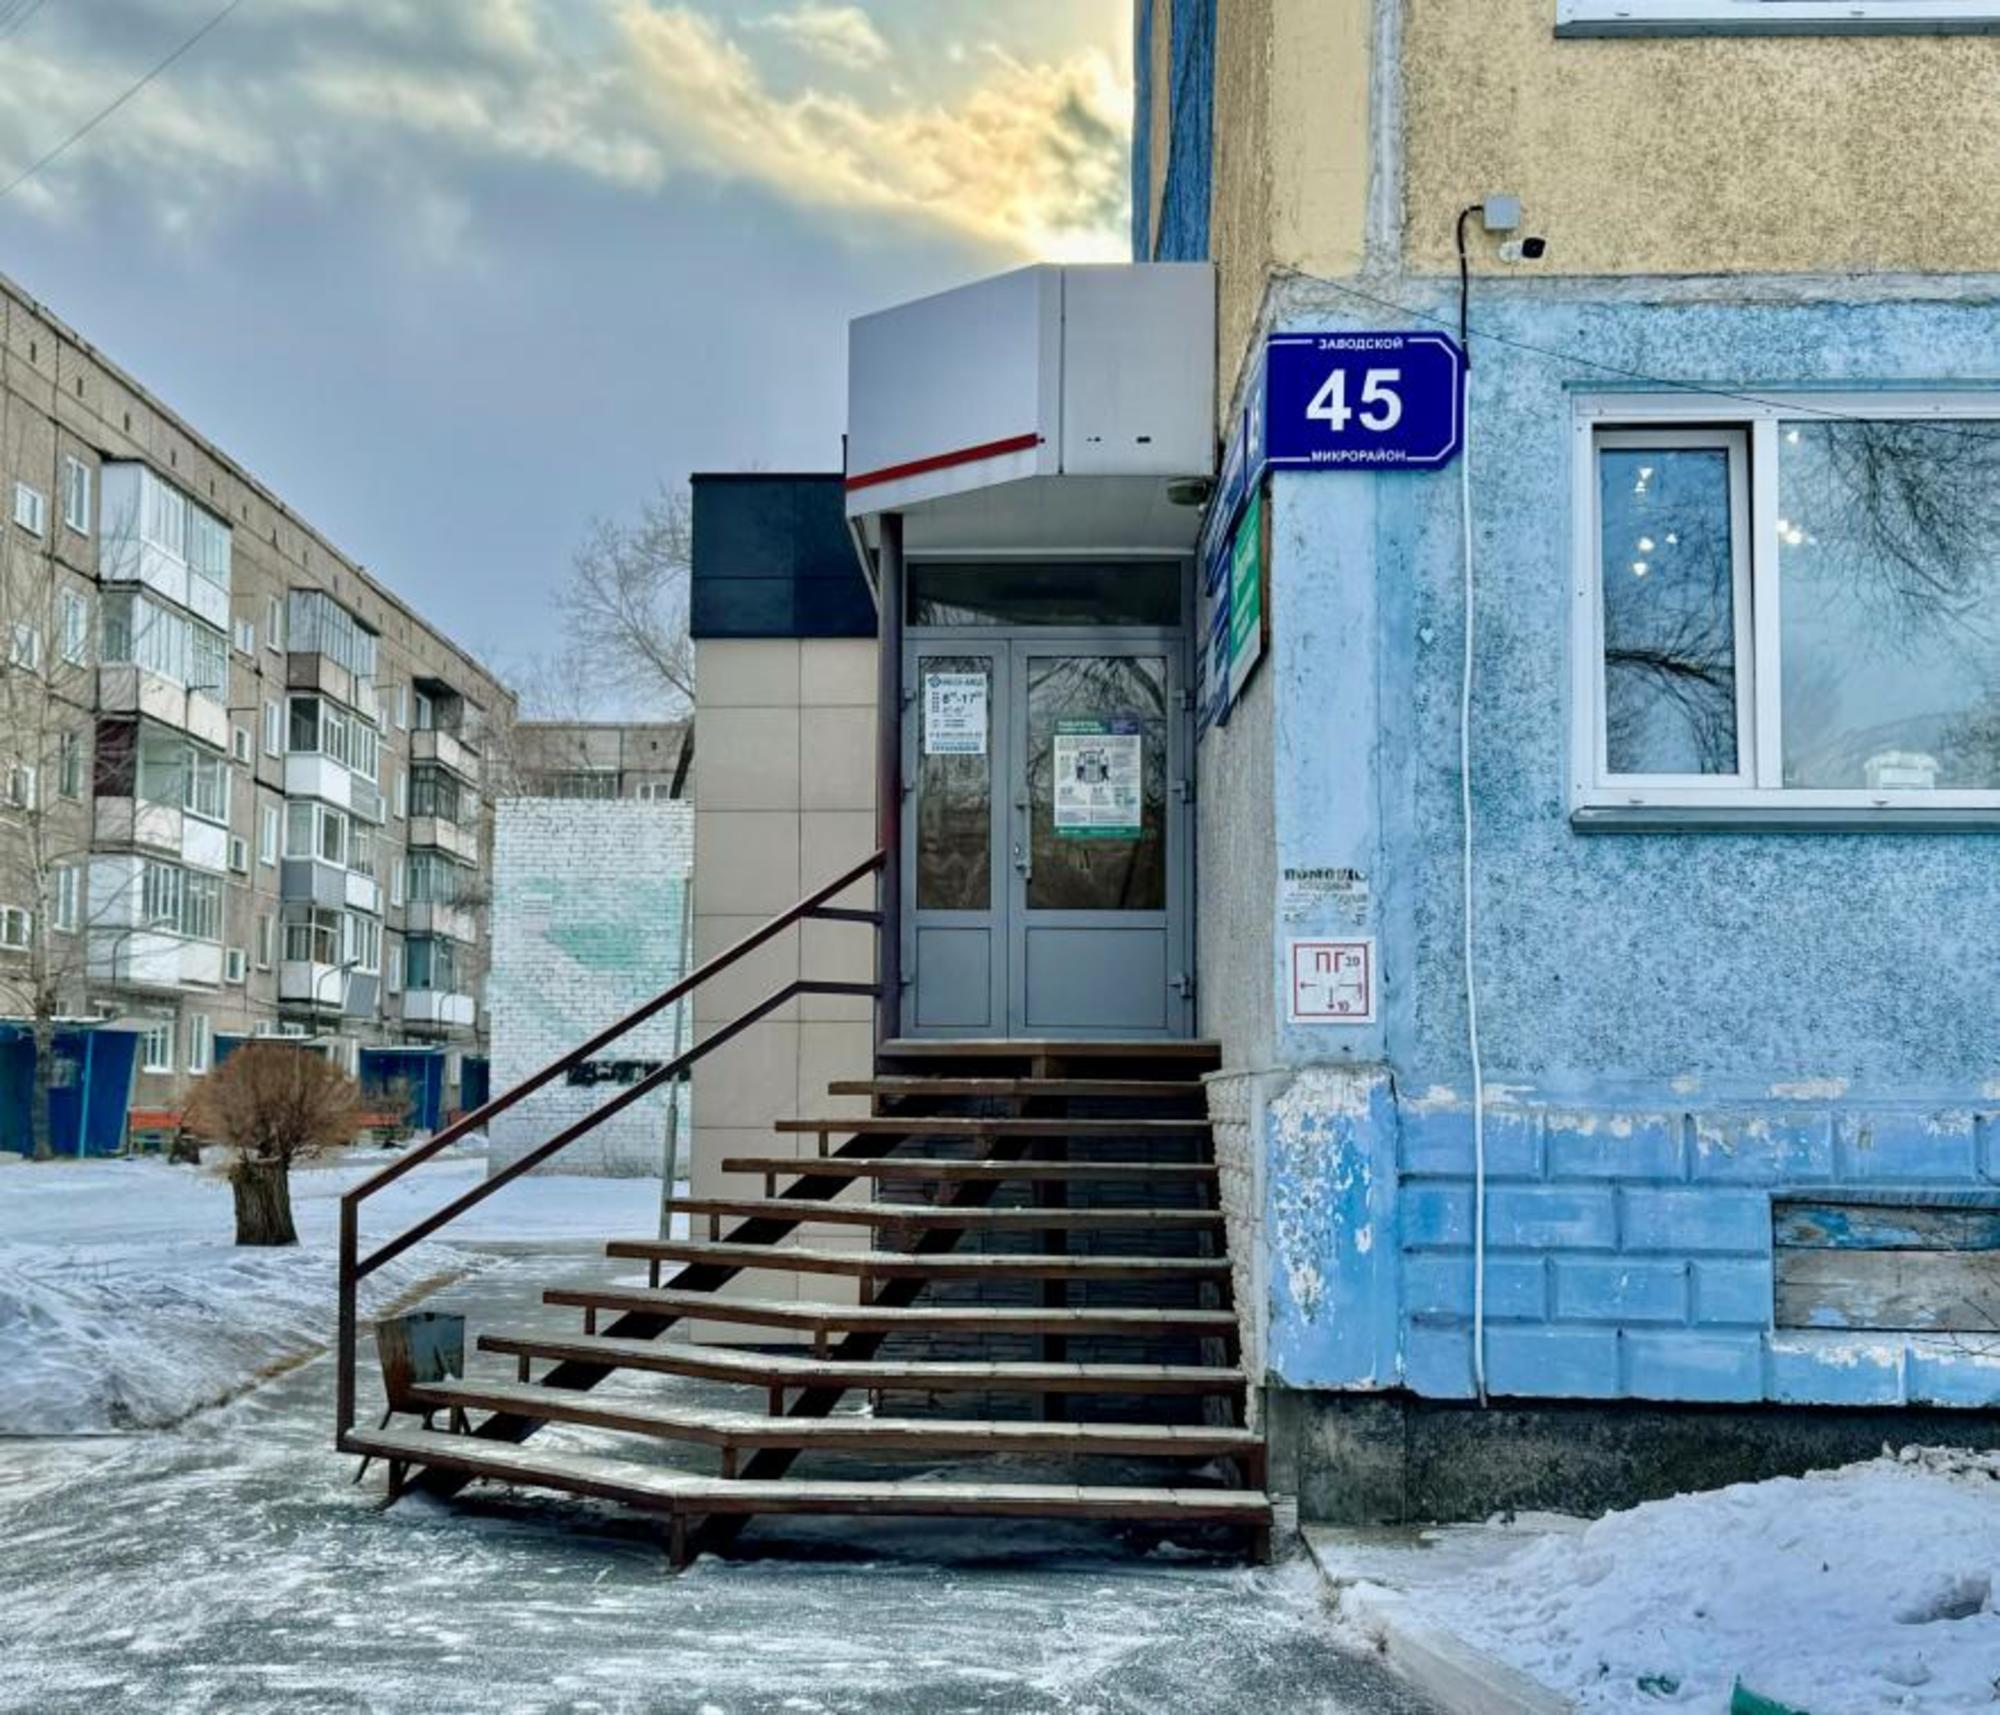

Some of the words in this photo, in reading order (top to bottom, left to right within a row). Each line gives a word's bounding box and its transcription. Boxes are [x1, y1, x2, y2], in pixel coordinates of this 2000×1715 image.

[1318, 337, 1404, 351] ЗАВОДСКОЙ
[1305, 368, 1402, 432] 45
[1311, 448, 1406, 463] МИКРОРАЙОН
[1316, 952, 1346, 974] ПГ
